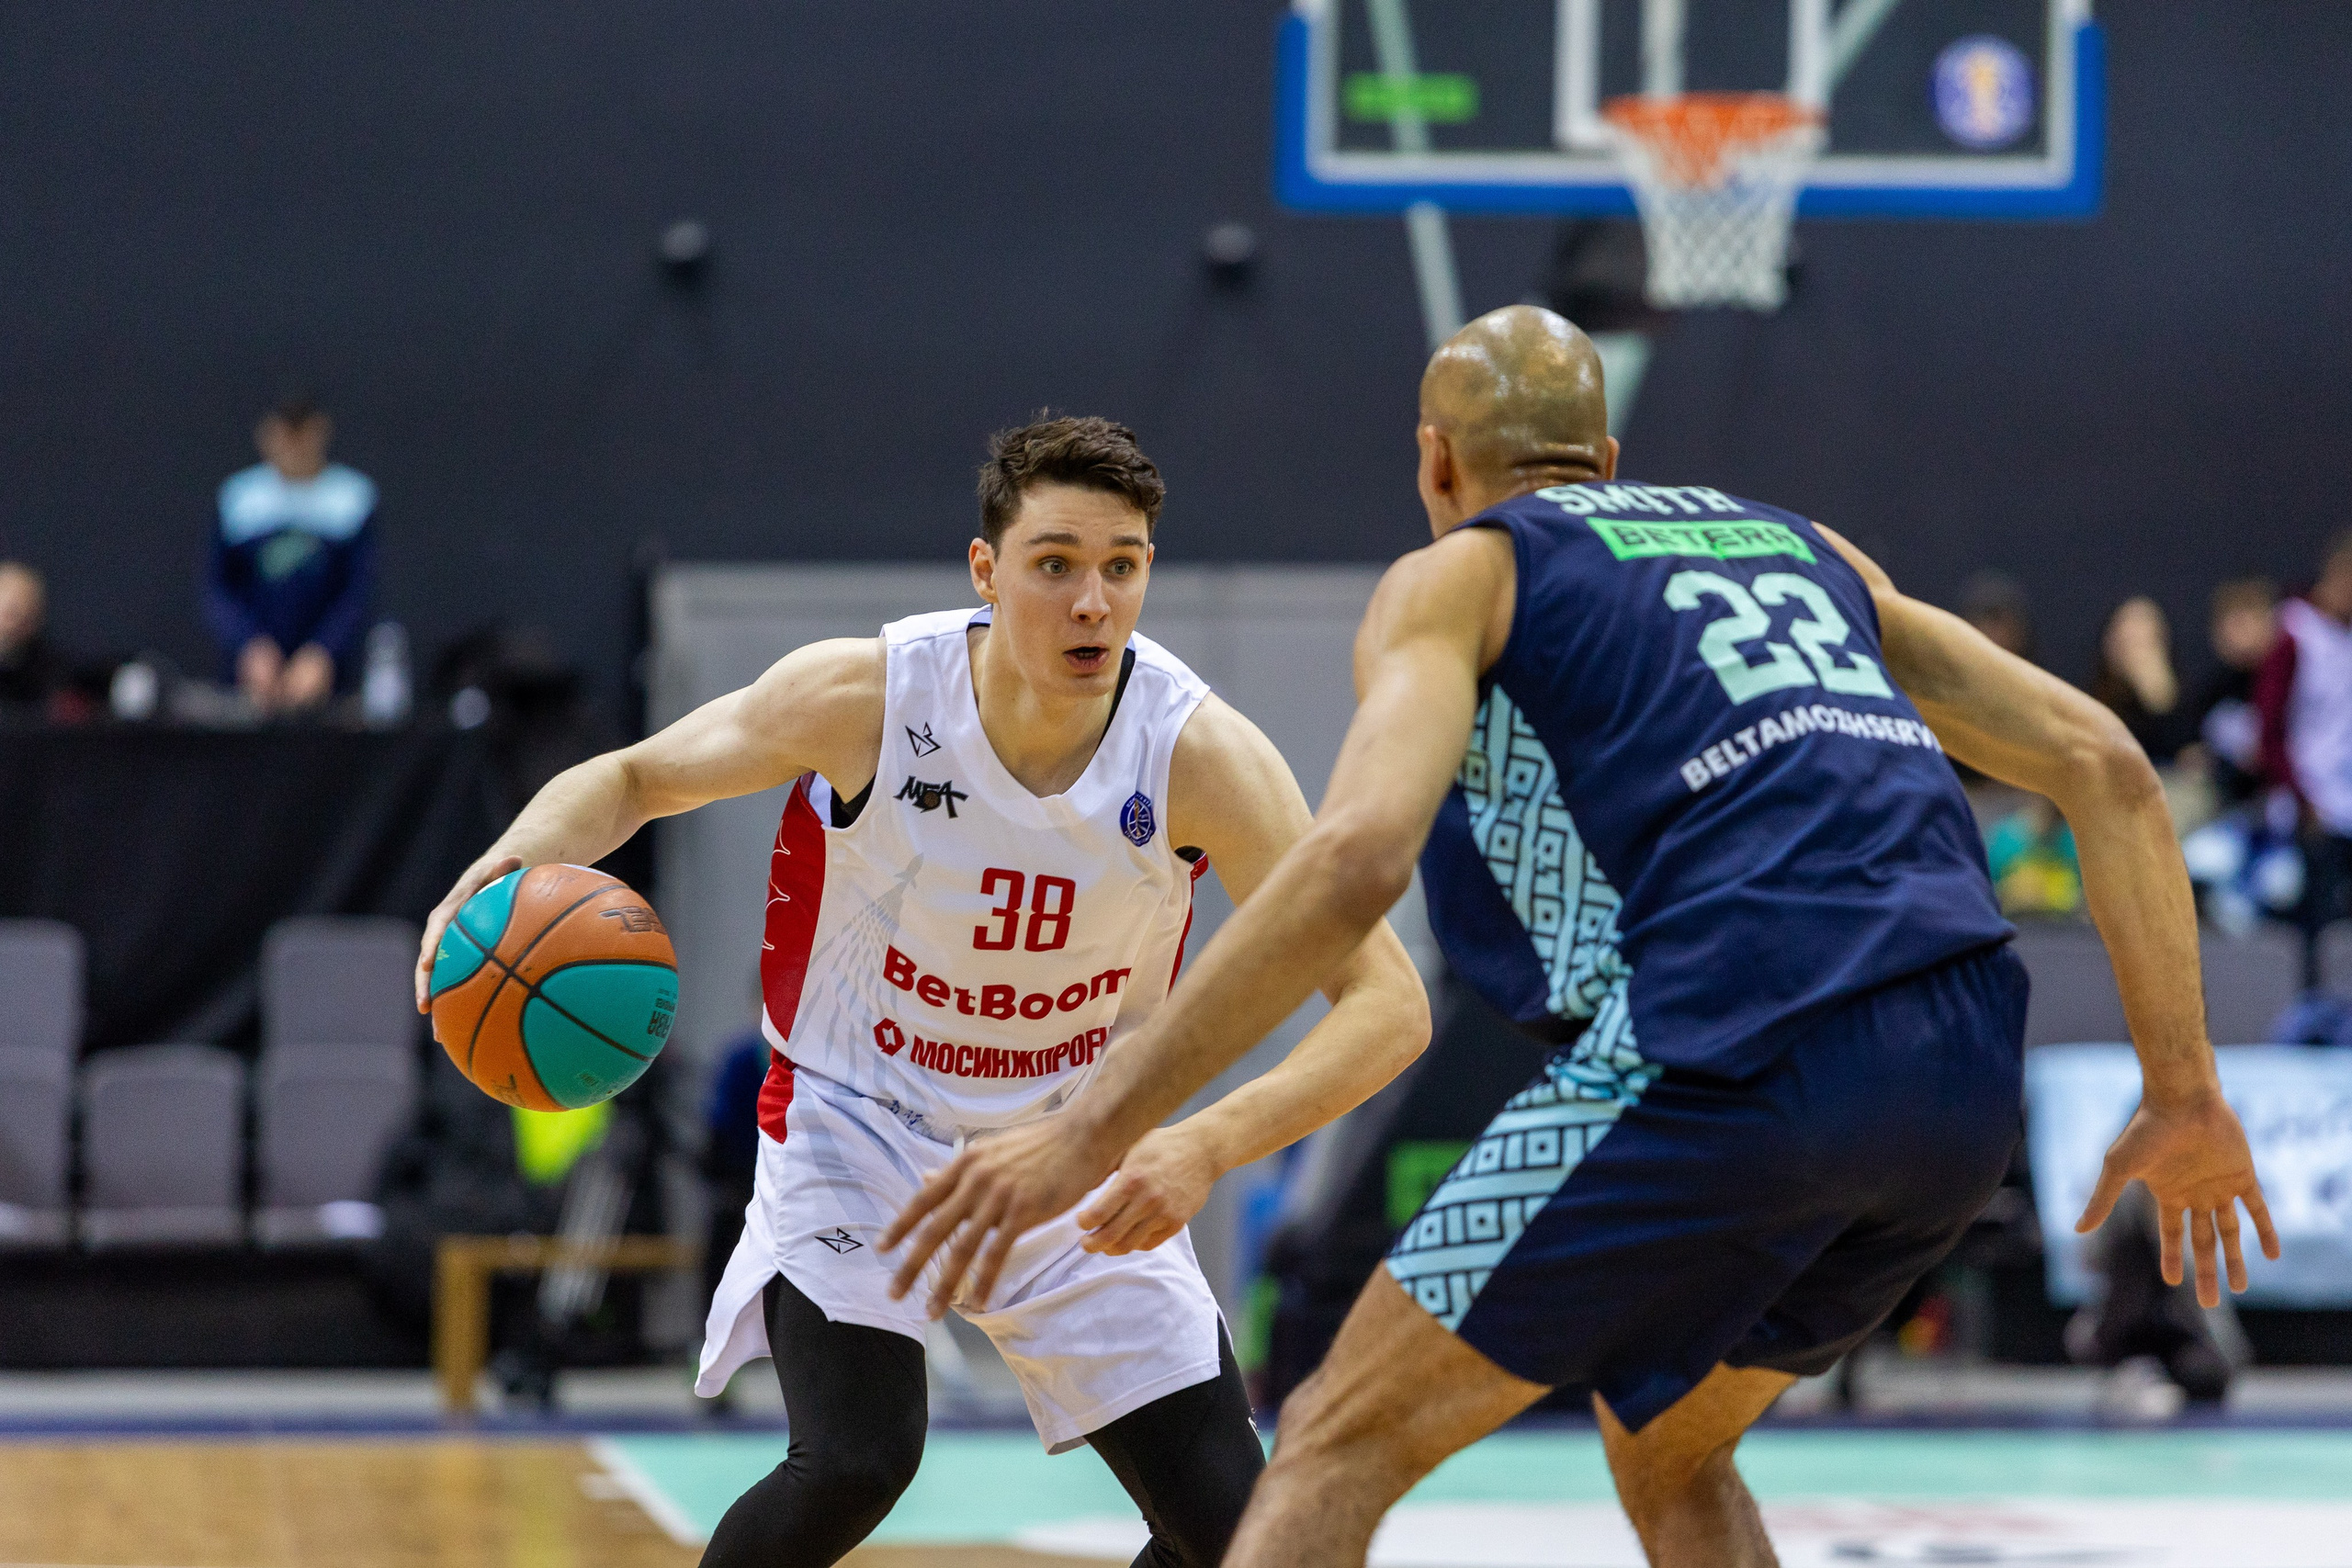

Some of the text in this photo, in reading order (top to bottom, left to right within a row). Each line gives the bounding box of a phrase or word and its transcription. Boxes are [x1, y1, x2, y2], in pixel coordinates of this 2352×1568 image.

[1535, 483, 1745, 515] SMITH
[1663, 570, 1894, 706] 22
[972, 867, 1076, 953] 38
[883, 944, 1133, 1021] BetBoom
